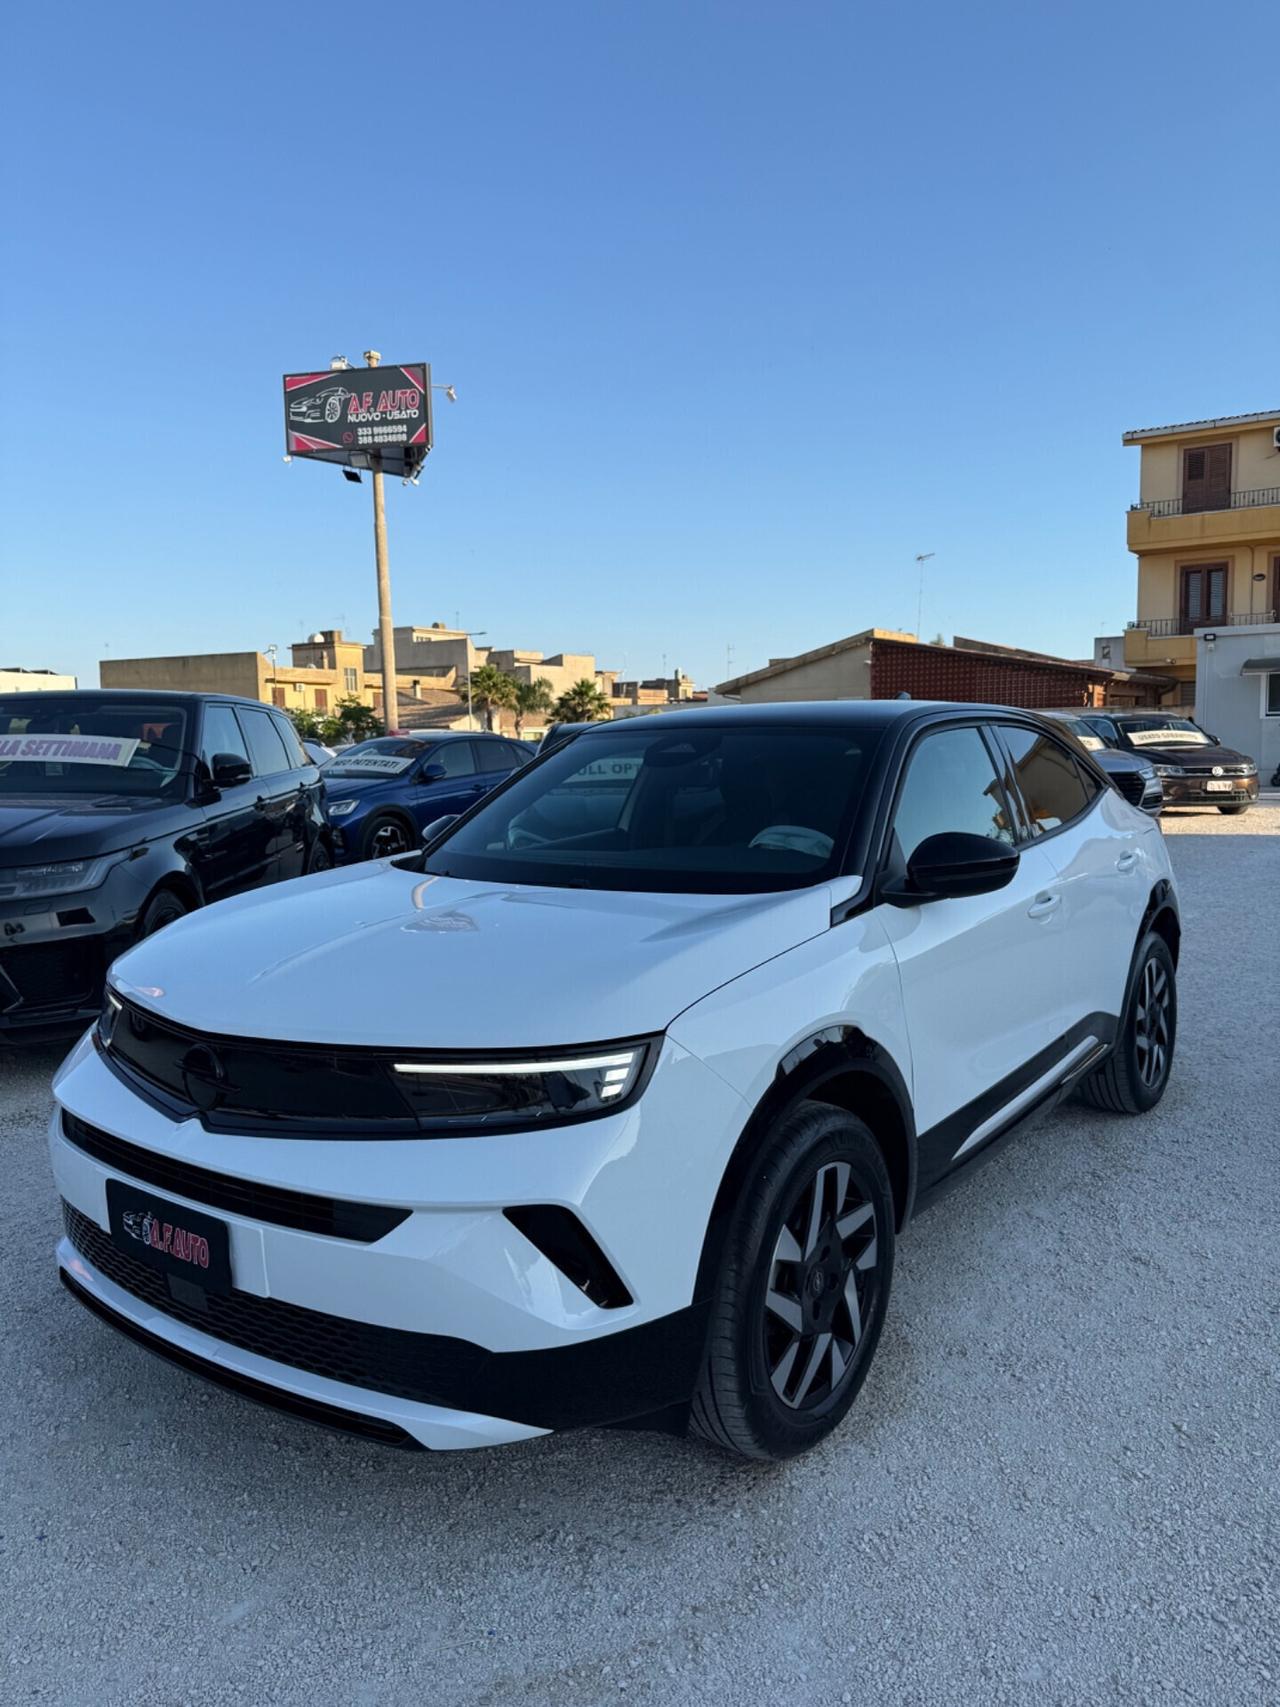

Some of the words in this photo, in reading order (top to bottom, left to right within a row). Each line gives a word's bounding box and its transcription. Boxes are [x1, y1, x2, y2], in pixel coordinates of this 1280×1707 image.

[348, 392, 374, 414] A.F.
[376, 388, 420, 412] AUTO
[347, 411, 381, 423] NUOVO
[386, 409, 419, 420] USATO
[0, 739, 21, 756] LA
